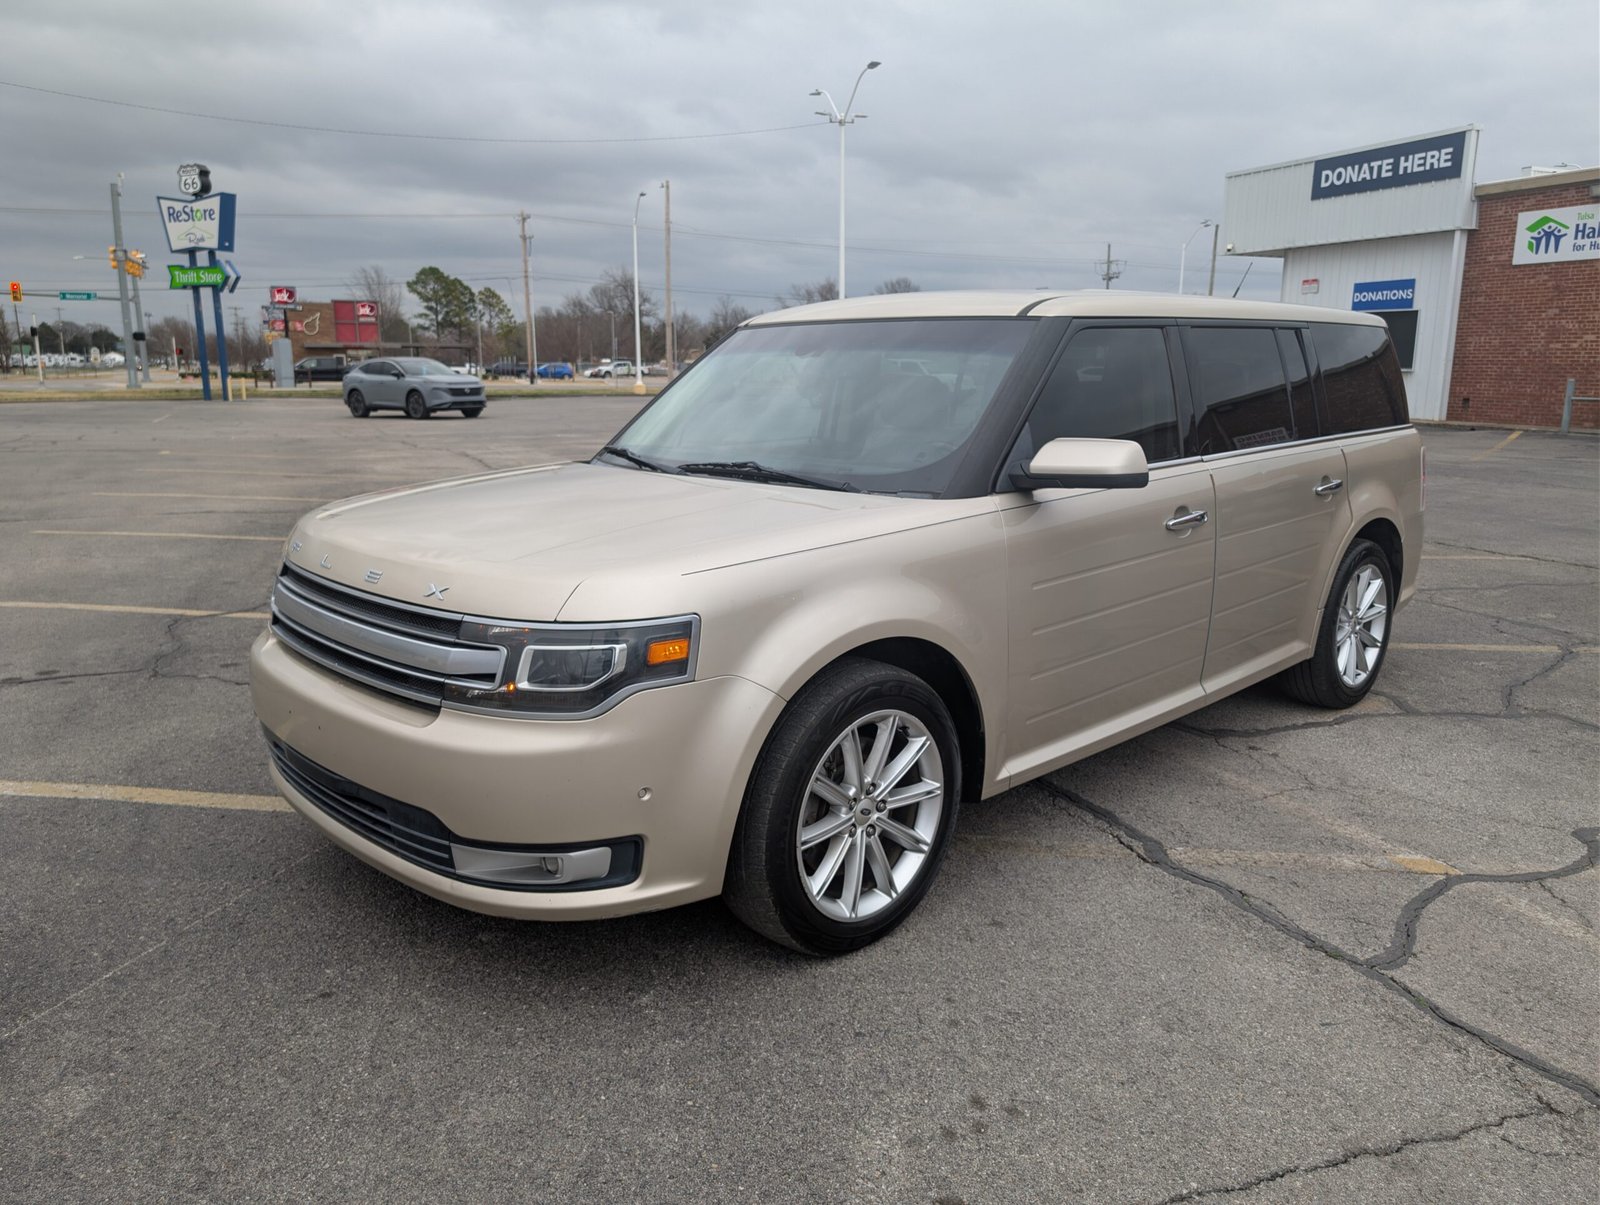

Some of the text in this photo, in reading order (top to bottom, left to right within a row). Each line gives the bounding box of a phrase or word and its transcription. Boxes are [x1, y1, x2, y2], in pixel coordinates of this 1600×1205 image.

[1320, 147, 1453, 188] DONATE HERE
[183, 177, 198, 191] 66
[167, 205, 216, 223] ReStore
[1577, 212, 1595, 221] Tulsa
[1572, 242, 1586, 252] for
[174, 270, 222, 283] Thrift Store
[1354, 288, 1413, 302] DONATIONS
[291, 541, 450, 601] FLEX
